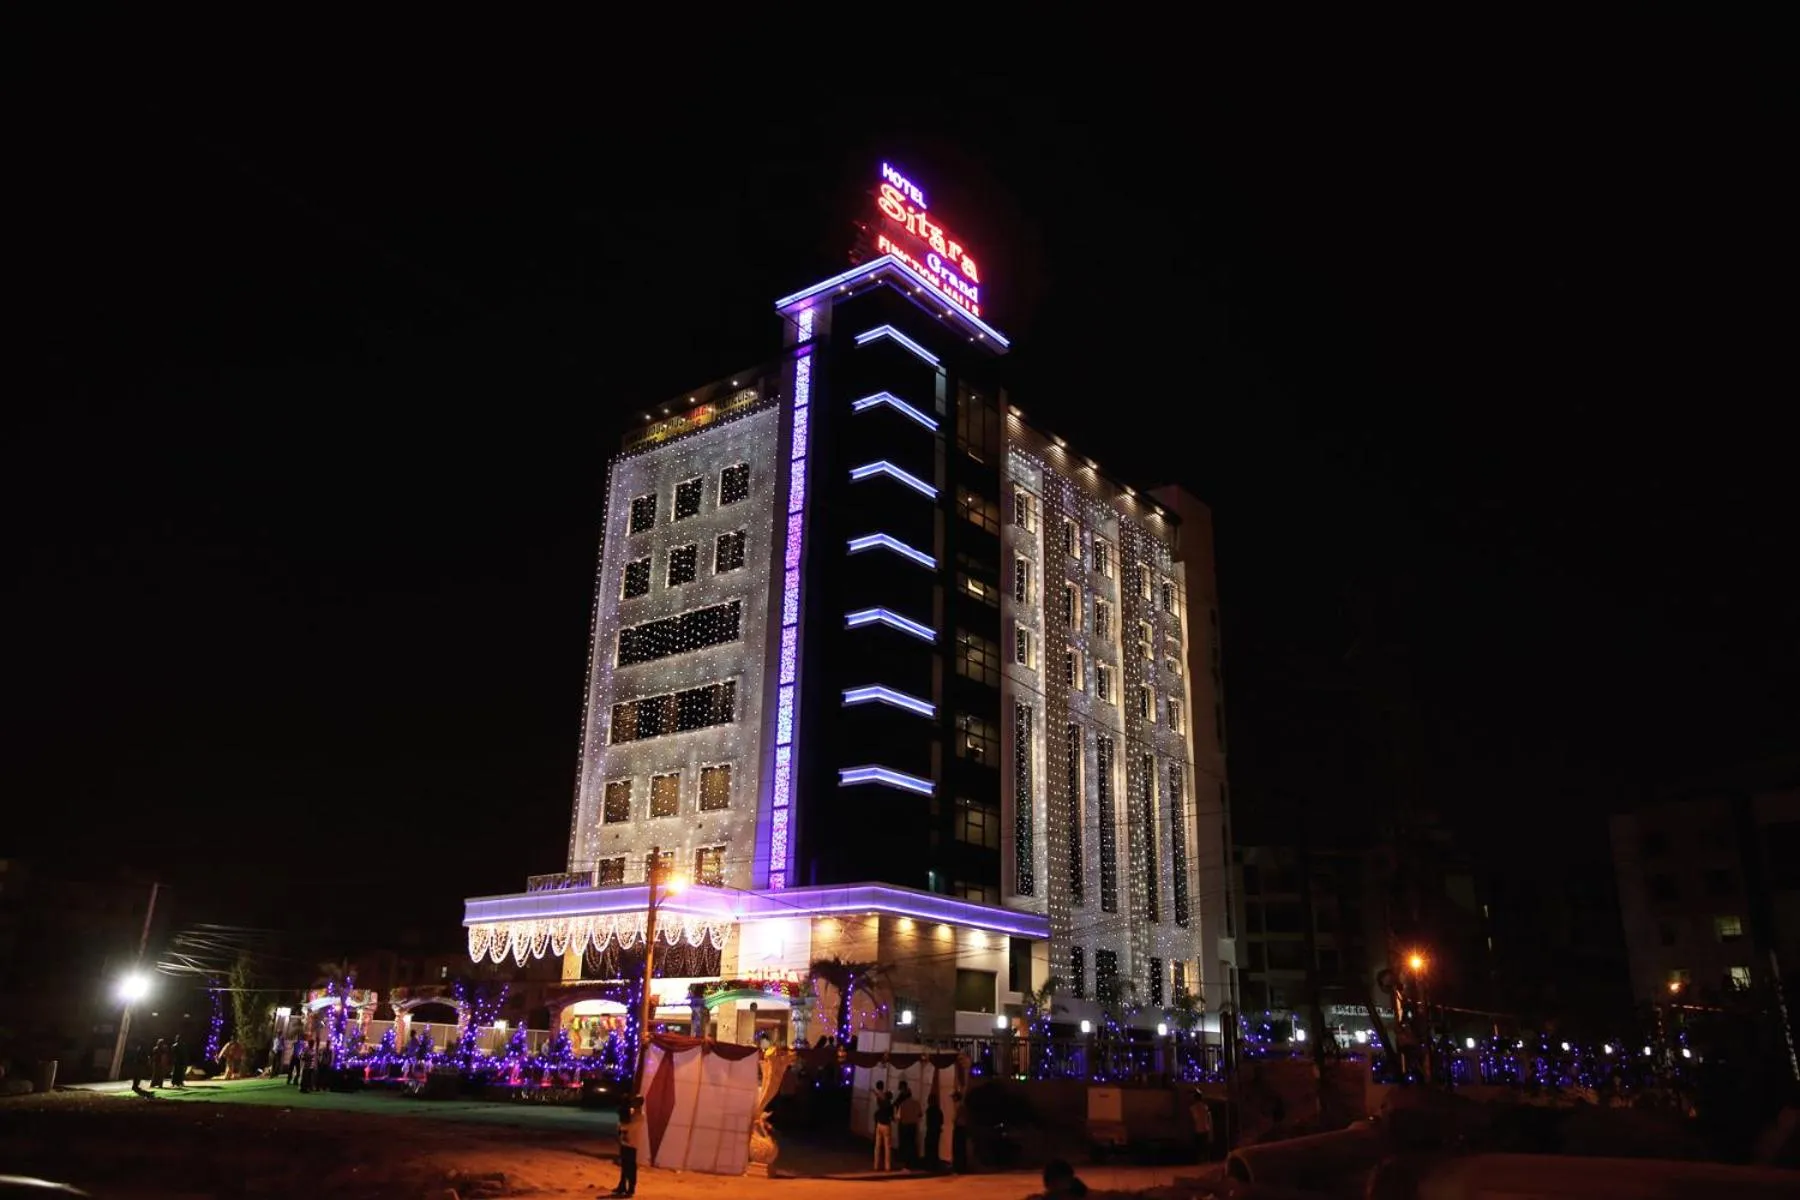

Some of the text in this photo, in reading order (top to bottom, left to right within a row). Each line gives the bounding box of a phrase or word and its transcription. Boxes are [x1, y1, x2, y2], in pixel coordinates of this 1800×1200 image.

[882, 162, 927, 209] HOTEL
[878, 183, 979, 283] Sitara
[926, 252, 979, 303] Grand
